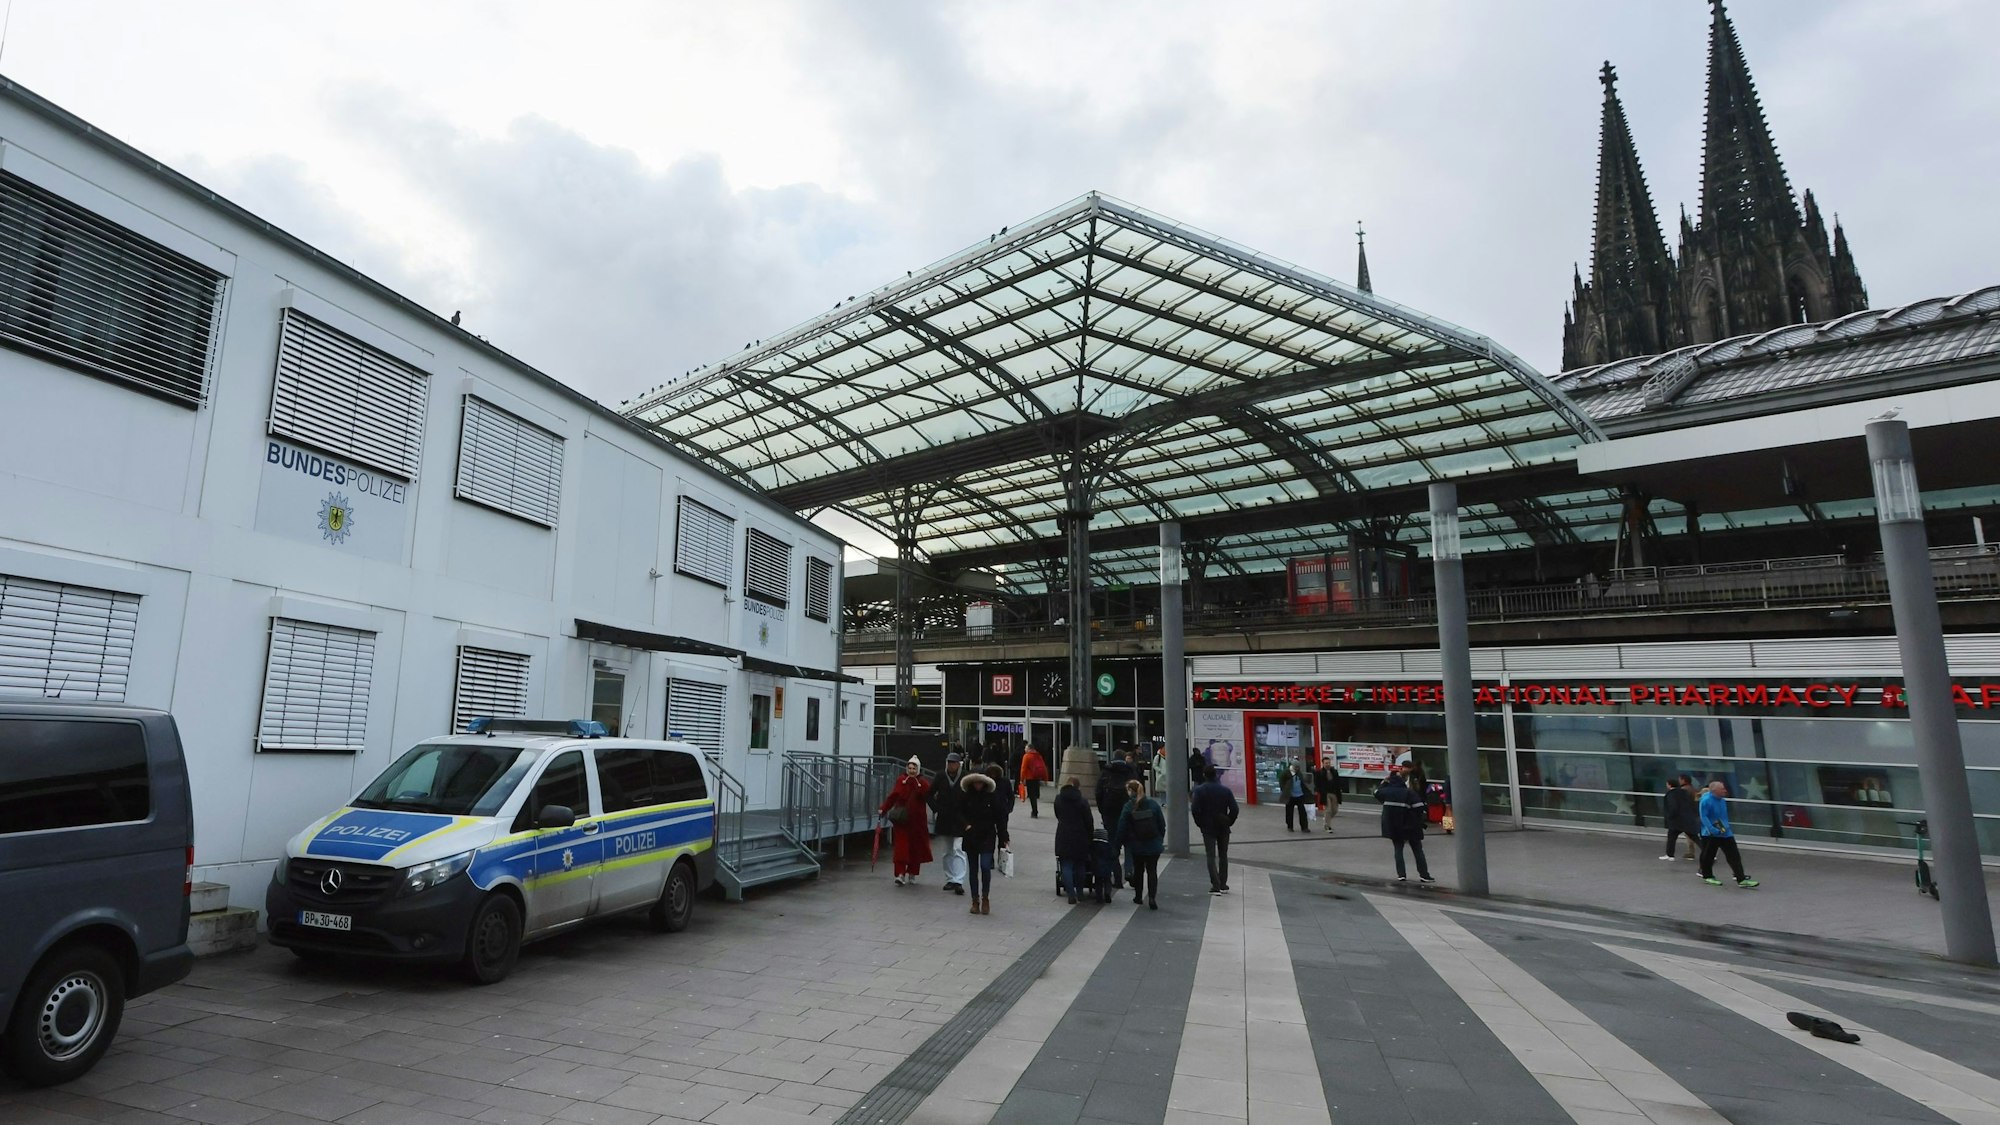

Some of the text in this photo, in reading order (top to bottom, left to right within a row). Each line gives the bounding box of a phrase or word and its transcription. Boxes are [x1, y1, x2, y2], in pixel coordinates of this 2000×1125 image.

[267, 442, 406, 505] BUNDESPOLIZEI
[995, 678, 1010, 692] DB
[1100, 676, 1112, 693] S
[1216, 684, 1860, 708] APOTHEKE INTERATIONAL PHARMACY
[324, 824, 412, 842] POLIZEI
[615, 831, 656, 855] POLIZEI
[304, 912, 349, 929] BP 30-468
